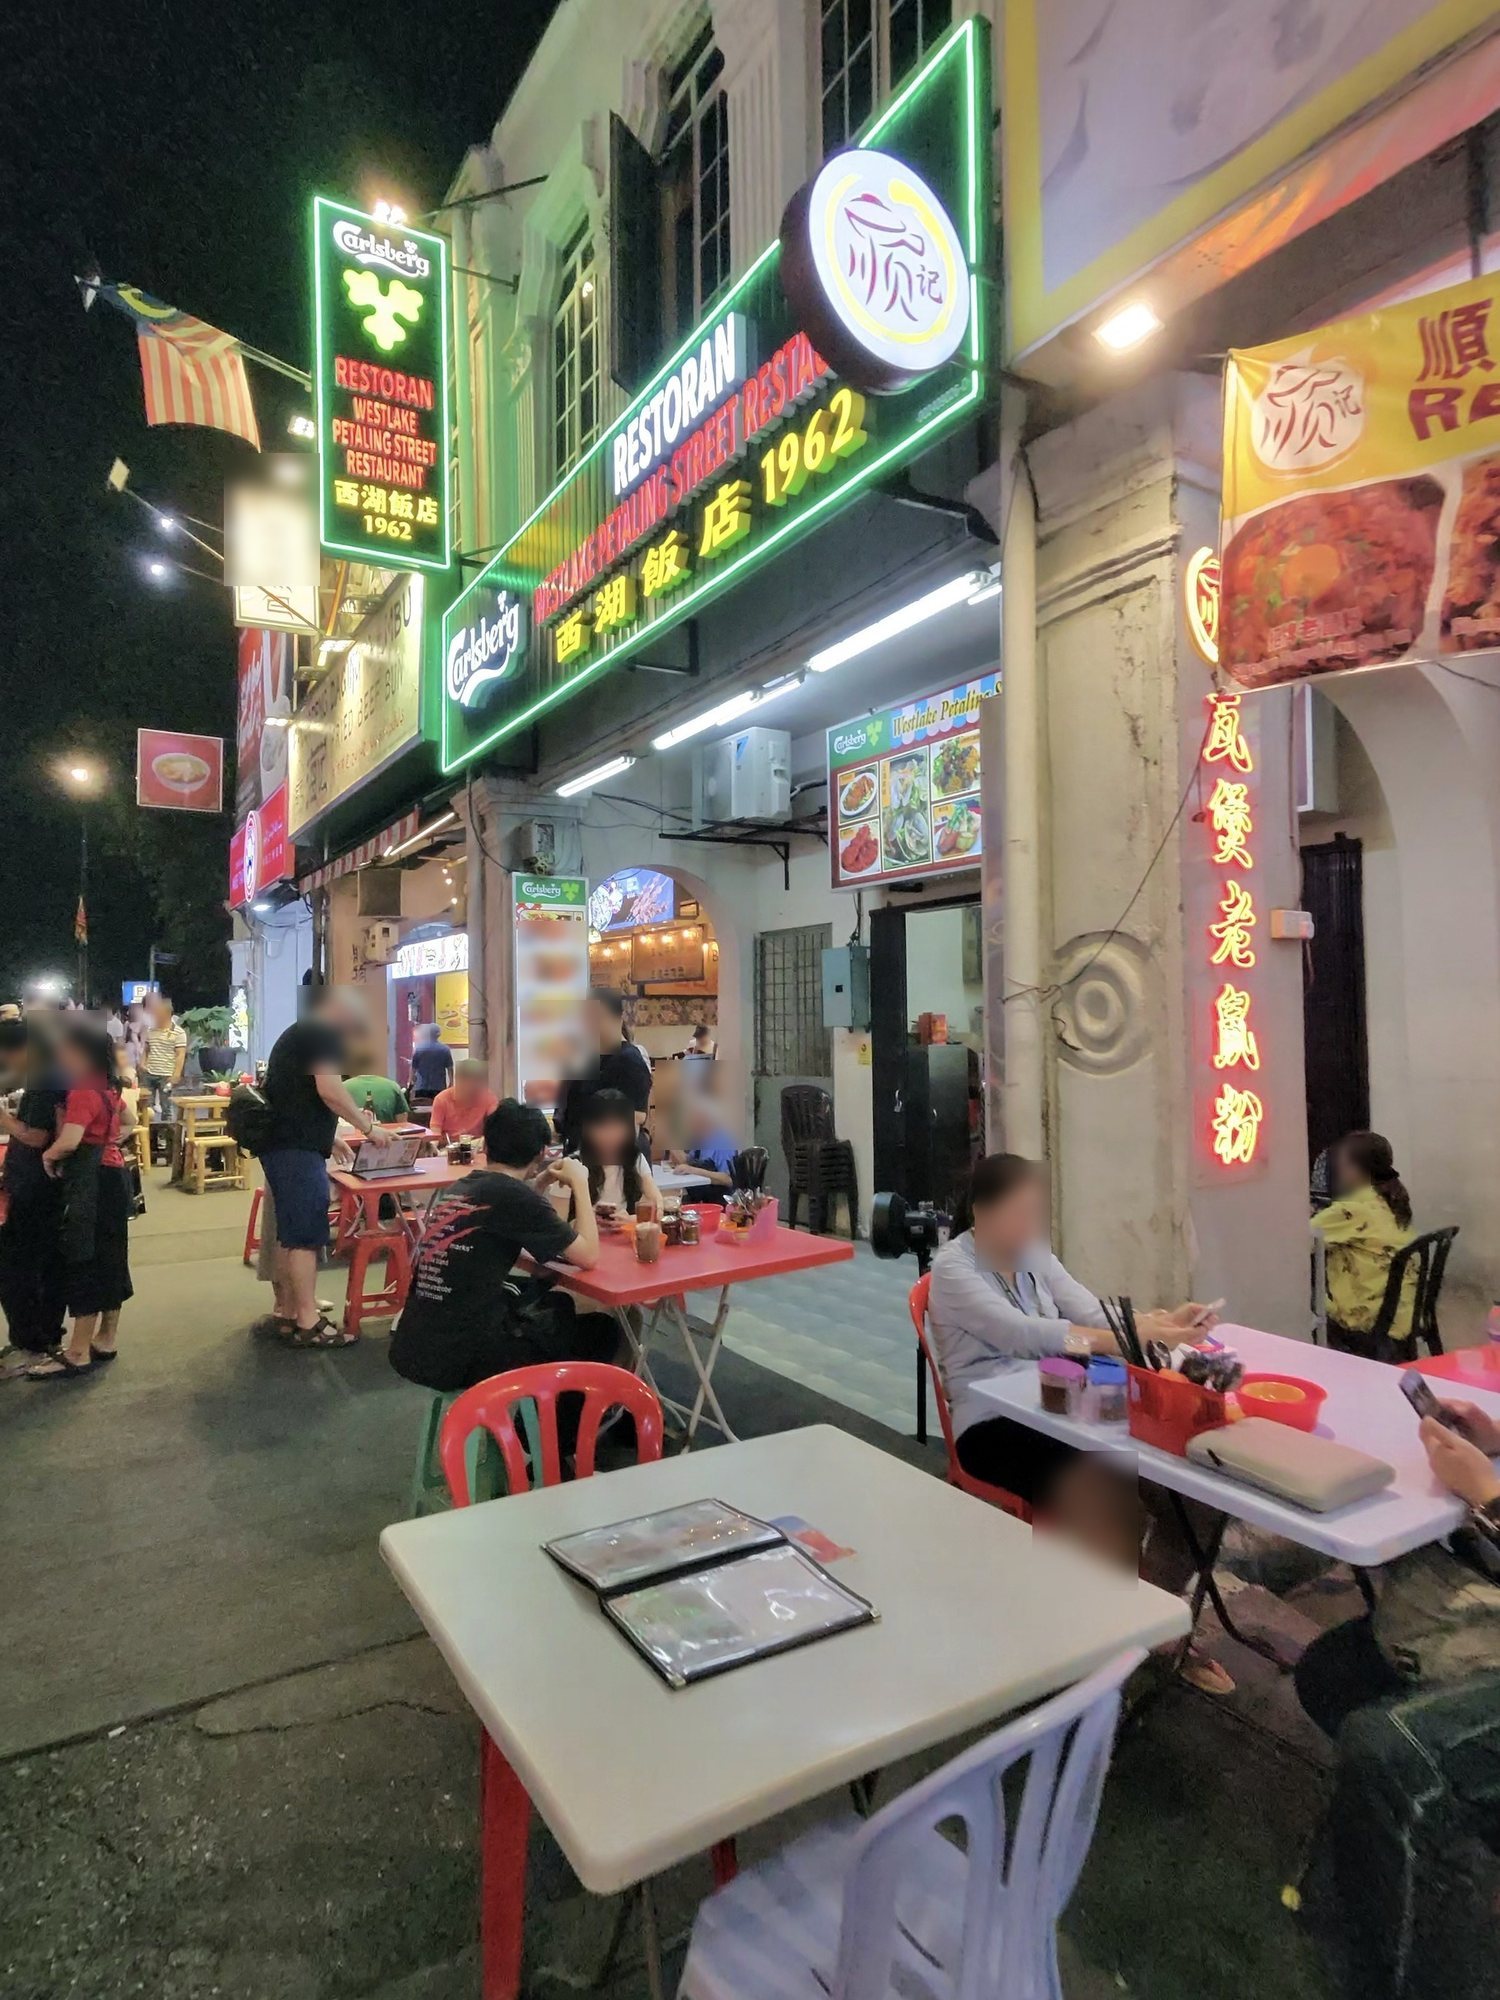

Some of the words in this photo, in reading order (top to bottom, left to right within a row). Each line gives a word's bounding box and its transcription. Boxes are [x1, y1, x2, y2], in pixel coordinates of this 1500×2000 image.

[332, 219, 430, 277] Carlsberg
[334, 355, 434, 409] RESTORAN
[614, 311, 736, 496] RESTORAN
[352, 396, 417, 435] WESTLAKE
[332, 418, 392, 455] PETALING
[392, 433, 437, 465] STREET
[346, 448, 425, 488] RESTAURANT
[334, 479, 439, 525] 西湖飯店
[533, 533, 595, 625] WESTLAKE
[597, 464, 668, 572] PETALING
[670, 394, 739, 505] STREET
[363, 514, 413, 541] 1962
[556, 480, 740, 663] 西湖飯店
[761, 388, 855, 505] 1962
[448, 600, 519, 704] Carlsberg
[834, 729, 867, 755] Carlsberg
[893, 708, 937, 738] Westlake
[522, 881, 561, 899] Carlsberg
